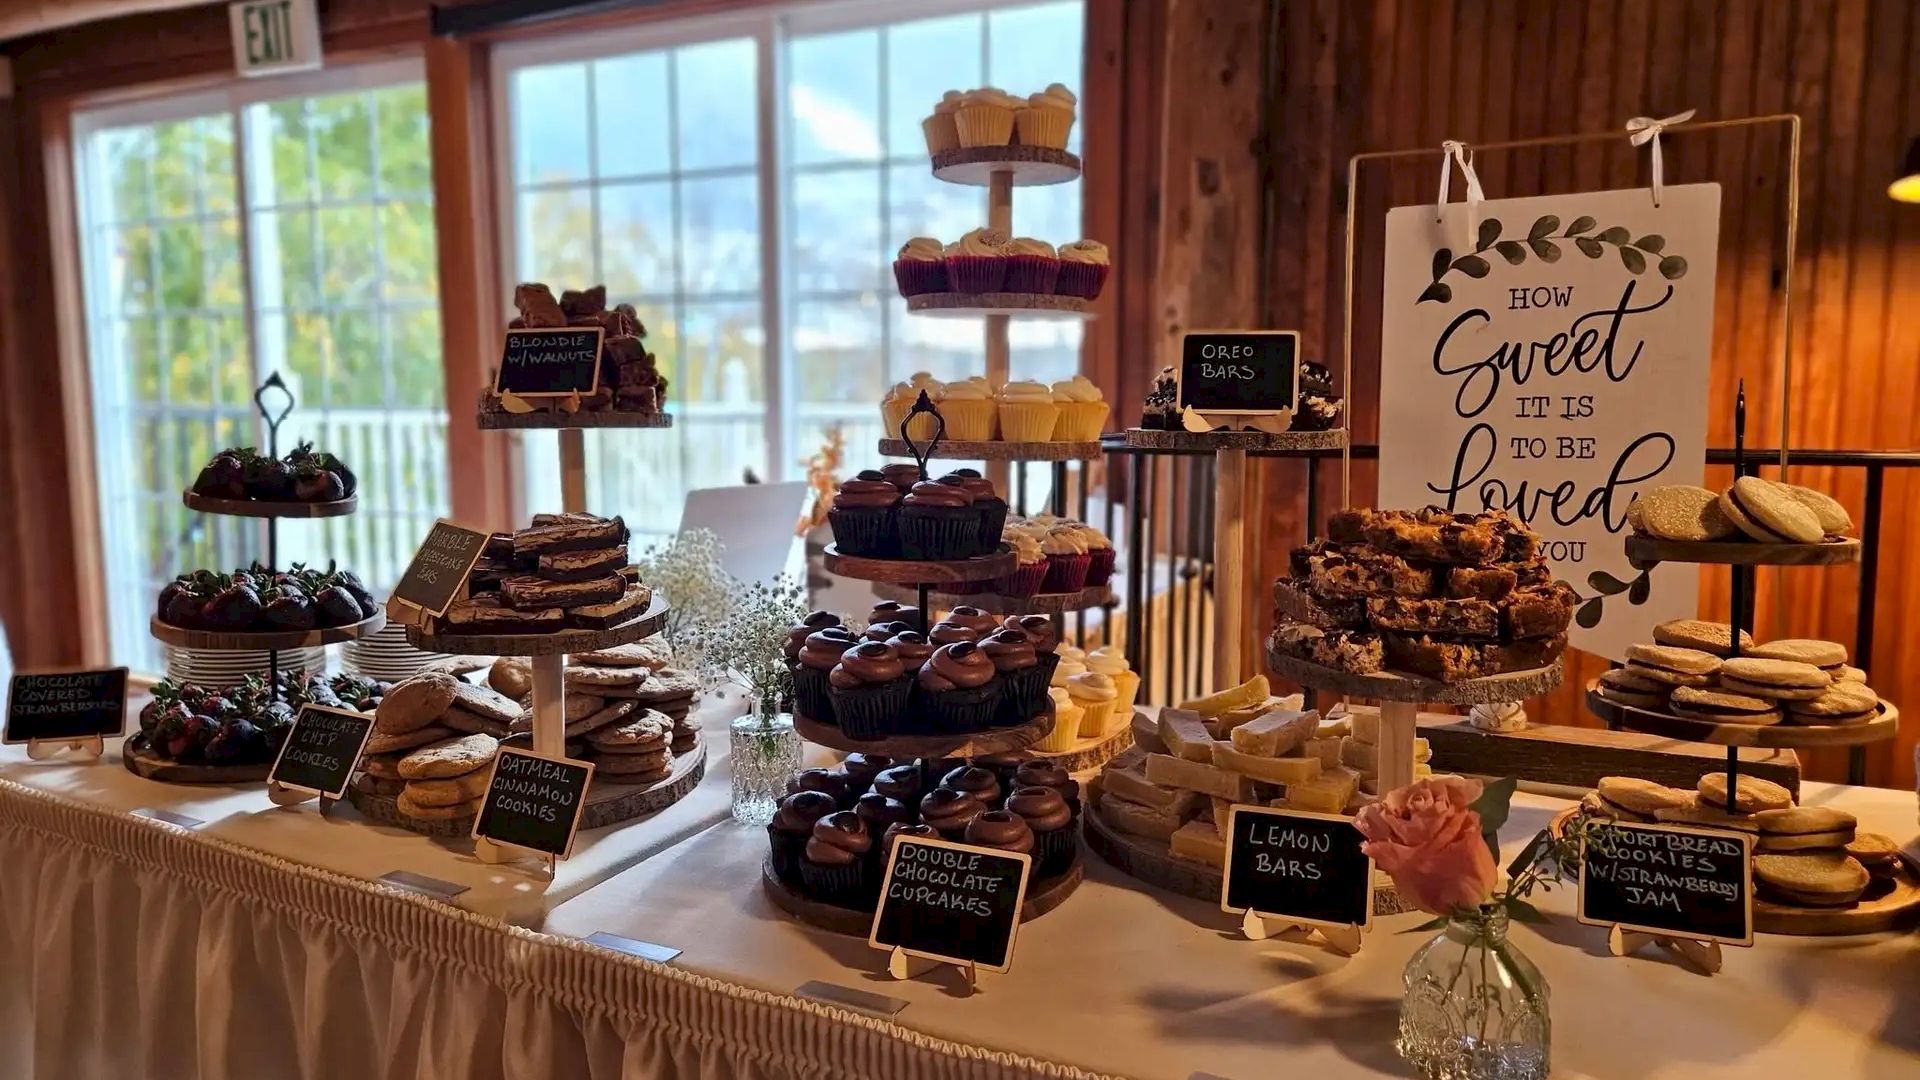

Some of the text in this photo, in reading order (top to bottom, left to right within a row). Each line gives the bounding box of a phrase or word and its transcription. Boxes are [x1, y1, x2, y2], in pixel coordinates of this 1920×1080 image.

[243, 1, 293, 64] EXIT
[1508, 286, 1574, 310] HOW
[510, 336, 585, 348] BLONDIE
[1202, 344, 1254, 359] OREO
[1433, 280, 1674, 418] Sweet
[1201, 363, 1255, 379] BARS
[1515, 395, 1594, 421] IT IS
[1511, 436, 1596, 459] TO BE
[15, 674, 105, 689] CHOCOLATE
[19, 689, 91, 702] COVERED
[301, 710, 363, 734] CHOCOLATE
[302, 730, 338, 746] CHIP
[285, 746, 339, 771] COOKIES
[501, 755, 570, 783] OATMEAL
[493, 777, 573, 805] CINNAMON
[496, 795, 556, 822] COOKIES
[1250, 823, 1330, 853] LEMON
[901, 844, 982, 870] DOUBLE
[1256, 853, 1322, 880] BARS
[894, 862, 1003, 893] CHOCOLATE
[889, 883, 992, 916] CUPCAKES
[1625, 886, 1682, 913] JAM
